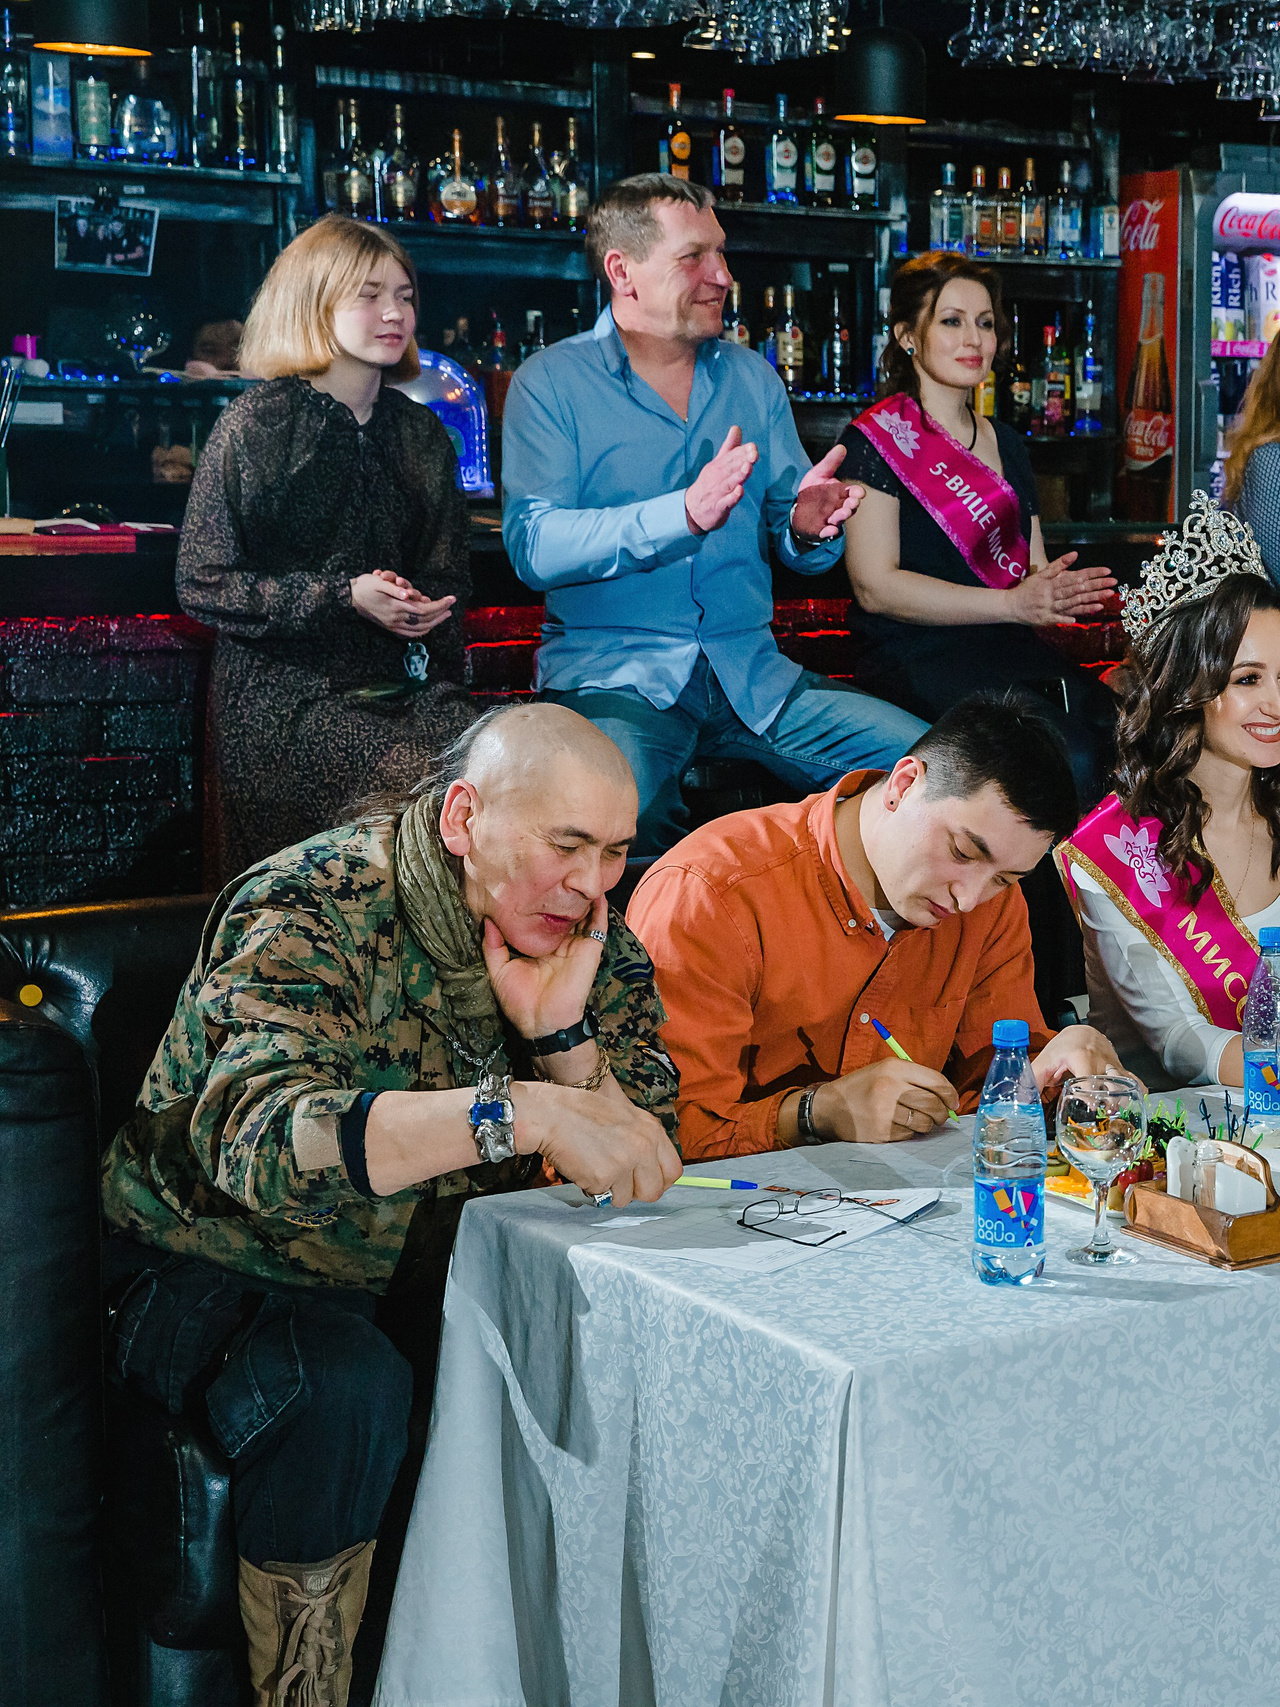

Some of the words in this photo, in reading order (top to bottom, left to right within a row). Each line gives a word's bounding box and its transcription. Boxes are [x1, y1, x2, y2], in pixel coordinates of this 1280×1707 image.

[1227, 267, 1241, 307] Rich
[929, 461, 996, 530] 5-ВИЦЕ
[1248, 1088, 1272, 1101] bon
[1248, 1099, 1280, 1112] aqua
[978, 1214, 1005, 1230] bon
[977, 1228, 1016, 1244] aqua
